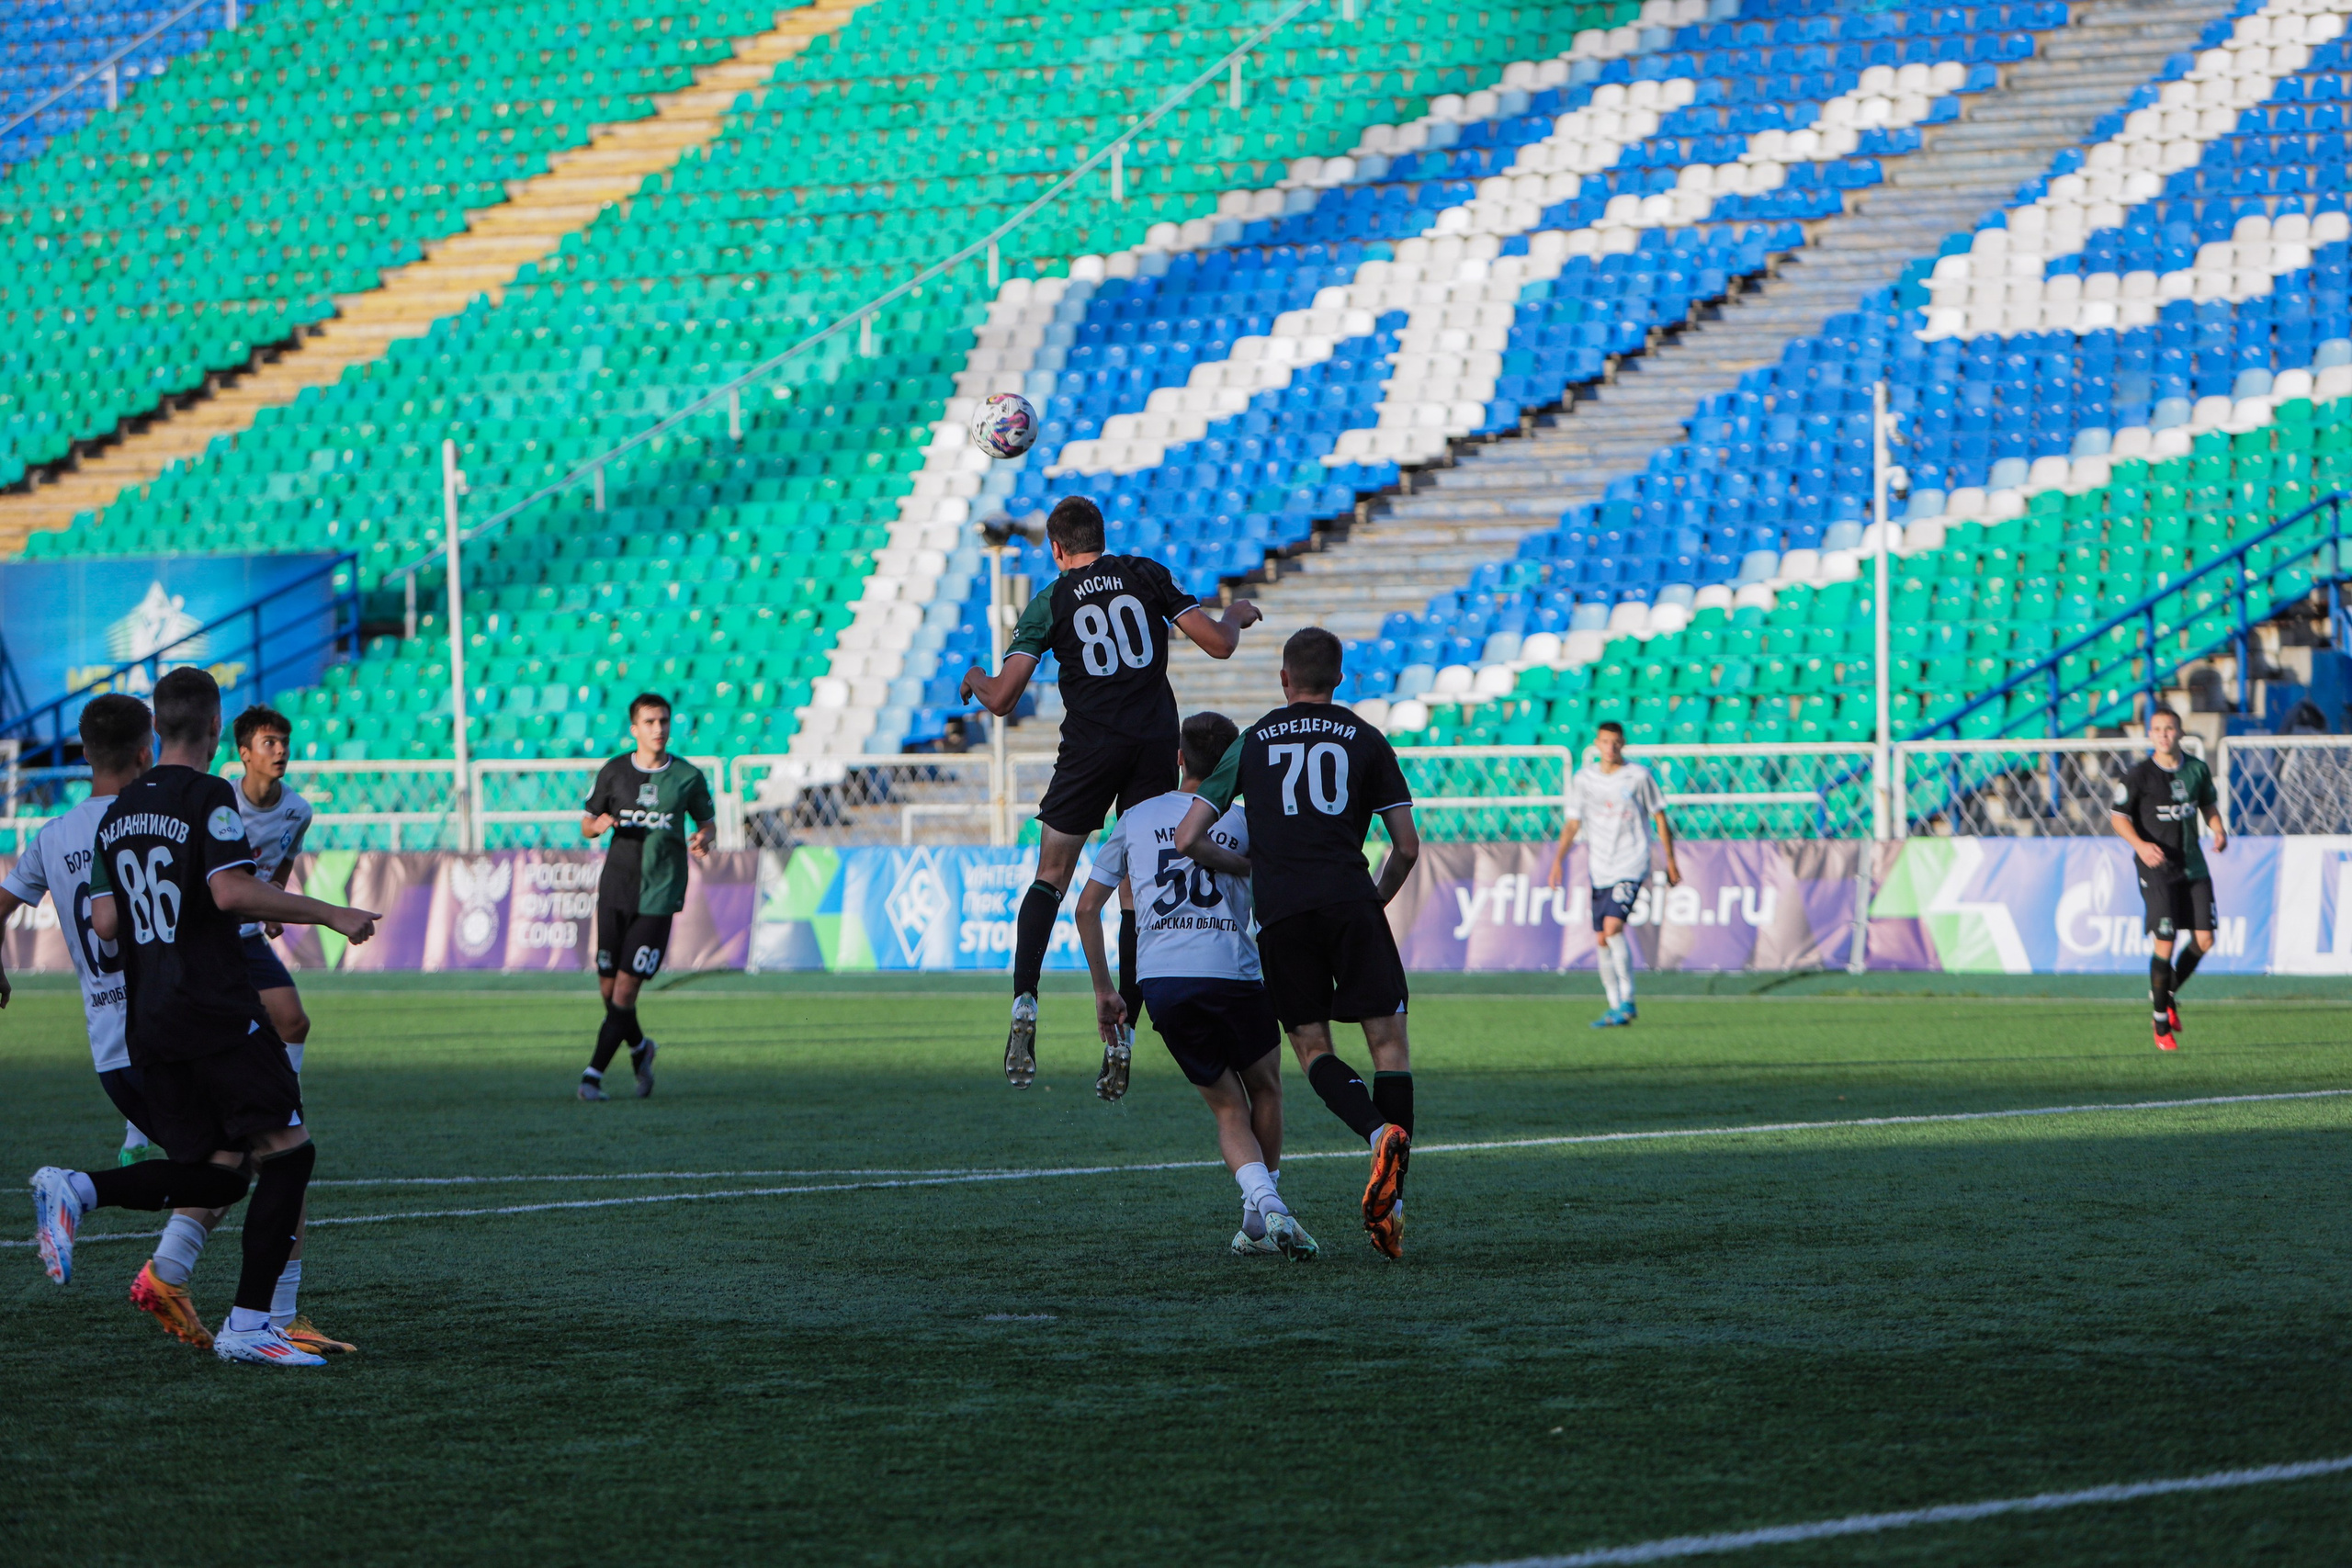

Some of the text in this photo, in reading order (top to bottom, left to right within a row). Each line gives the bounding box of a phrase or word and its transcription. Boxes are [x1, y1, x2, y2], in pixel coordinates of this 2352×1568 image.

[1073, 575, 1124, 601] МОСИН
[1073, 594, 1154, 676] 80
[1256, 717, 1357, 741] ПЕРЕДЕРИЙ
[1268, 741, 1350, 816] 70
[99, 813, 190, 852] ЖЕЛАННИКОВ
[117, 845, 182, 945] 86
[1453, 872, 1778, 941] yflrusia.ru
[516, 920, 578, 949] СОЮЗ
[1196, 917, 1238, 932] ОБЛАСТЬ
[632, 944, 661, 976] 68
